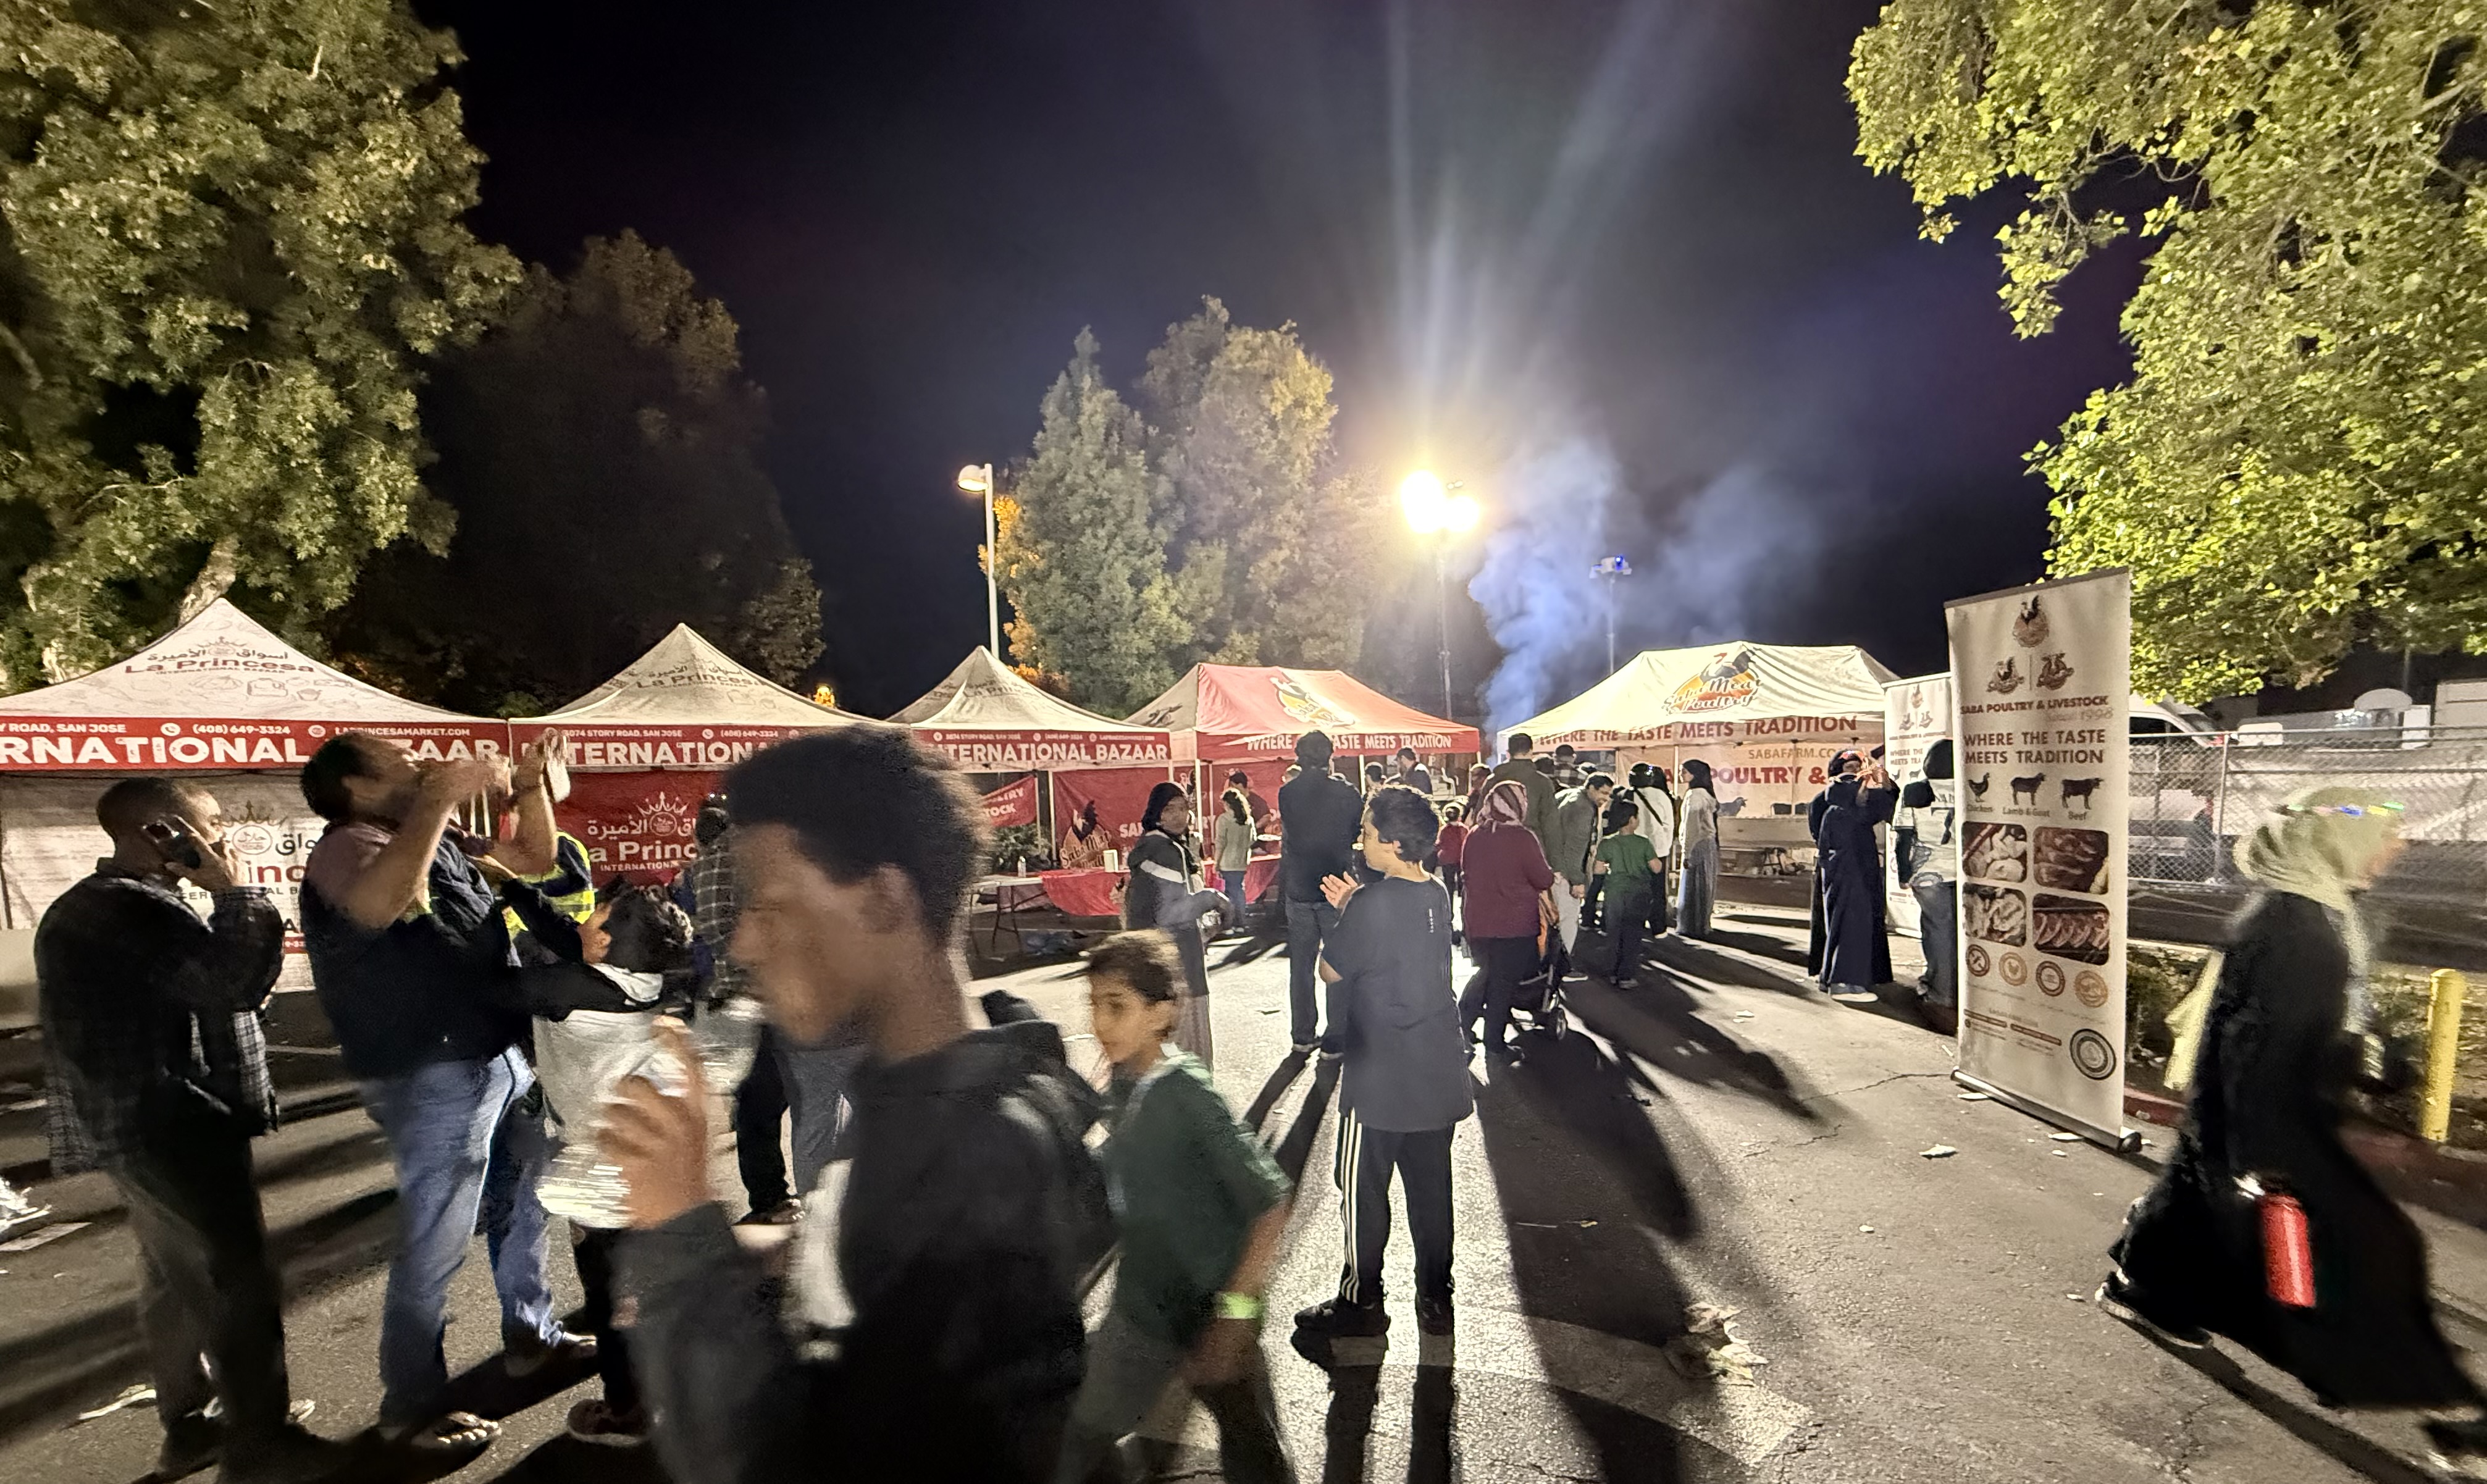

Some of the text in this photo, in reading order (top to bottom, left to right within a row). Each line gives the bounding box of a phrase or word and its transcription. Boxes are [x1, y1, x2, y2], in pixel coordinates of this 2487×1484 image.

[125, 658, 314, 674] La Princesa
[1986, 701, 2034, 713] POULTRY
[2036, 700, 2045, 710] &
[2047, 695, 2108, 709] LIVESTOCK
[9, 723, 55, 733] ROAD,
[56, 724, 86, 732] SAN
[88, 724, 127, 733] JOSE
[192, 724, 291, 735] (408) 649-3324
[1593, 730, 1618, 741] THE
[1679, 722, 1734, 739] MEETS
[1745, 716, 1857, 736] TRADITION
[1364, 735, 1396, 750] MEETS
[1399, 734, 1451, 749] TRADITION
[1964, 729, 2106, 747] WHERE THE TASTE
[926, 743, 1167, 761] TERNATIONAL BAZAAR
[1965, 749, 2104, 765] MEETS TRADITION
[1808, 767, 1827, 784] &
[2003, 807, 2024, 816] Lamb
[2068, 811, 2087, 821] Beef
